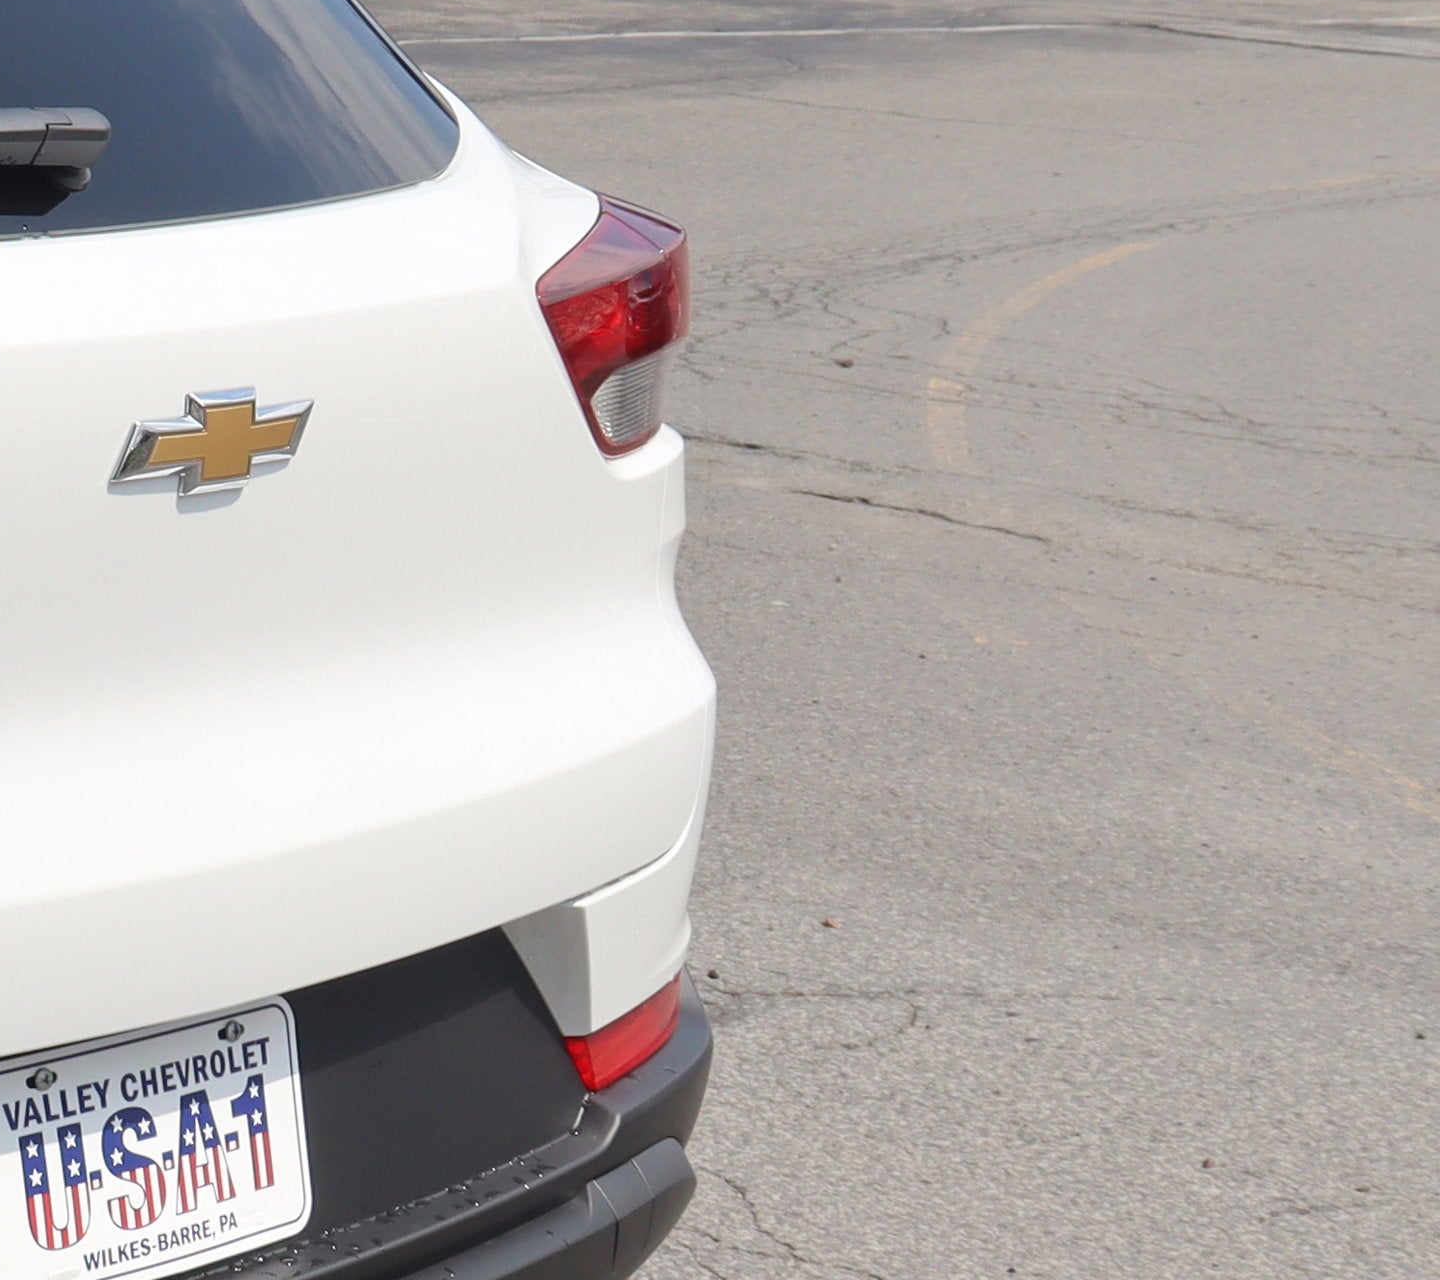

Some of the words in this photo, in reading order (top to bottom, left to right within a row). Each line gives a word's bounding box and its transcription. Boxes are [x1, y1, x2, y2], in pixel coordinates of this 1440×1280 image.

[2, 1078, 111, 1131] VALLEY
[120, 1037, 270, 1102] CHEVROLET
[83, 1219, 216, 1271] WILKES-BARRE,
[219, 1211, 238, 1236] PA
